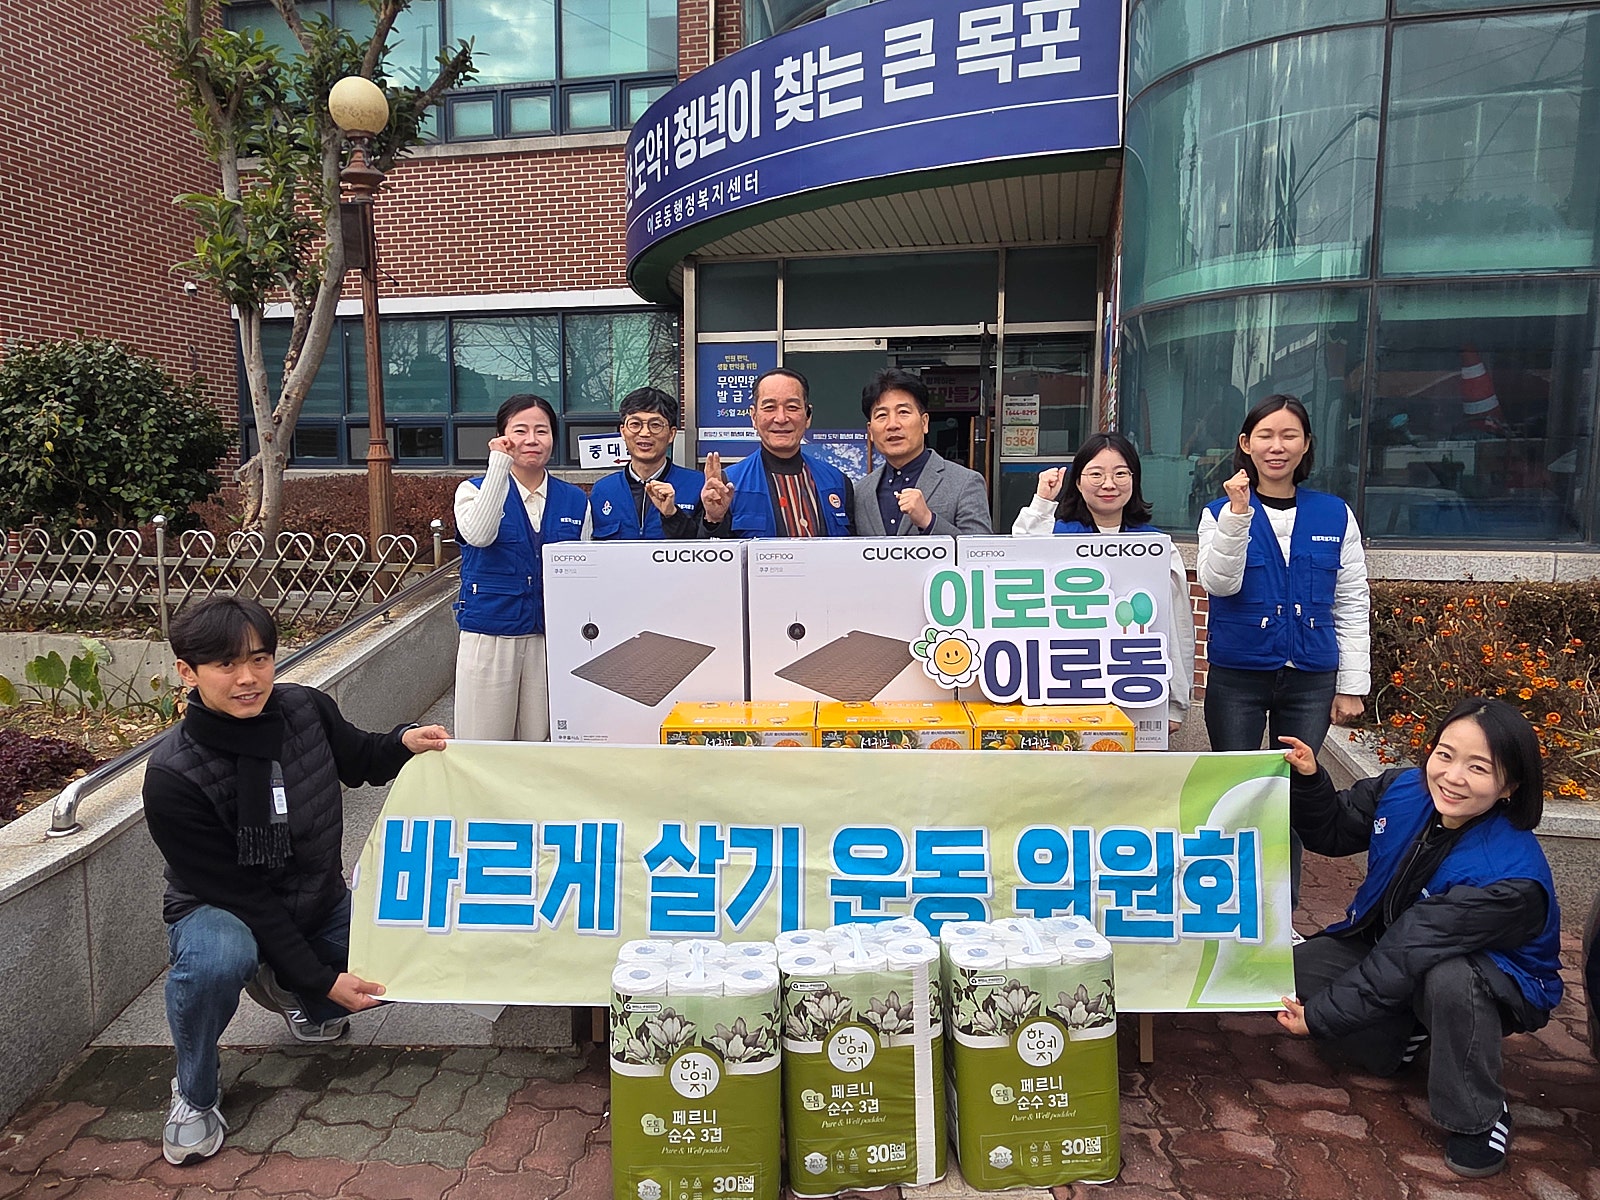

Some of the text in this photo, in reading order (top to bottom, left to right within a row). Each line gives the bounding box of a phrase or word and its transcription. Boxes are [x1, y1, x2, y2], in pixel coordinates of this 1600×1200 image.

[634, 116, 669, 200] 도약!
[673, 70, 761, 170] 청년이
[774, 46, 863, 131] 찾는
[882, 18, 935, 103] 큰
[956, 0, 1080, 83] 목표
[647, 169, 758, 235] 이로동행정복지센터
[1005, 436, 1035, 446] 5364
[652, 549, 734, 563] CUCKOO
[862, 546, 947, 561] CUCKOO
[1076, 543, 1163, 558] CUCKOO
[929, 567, 1110, 629] 이로운
[983, 638, 1167, 702] 이로동
[861, 736, 891, 749] 서귀포
[1021, 736, 1051, 749] 서귀포
[375, 817, 1260, 942] 바르게 살기 운동 위원회
[831, 1081, 873, 1099] 페르니
[1020, 1075, 1063, 1092] 페르니
[827, 1098, 879, 1116] 순수 3겹
[1016, 1092, 1069, 1111] 순수 3겹
[672, 1109, 717, 1125] 페르니
[821, 1120, 837, 1129] Pure
[1010, 1114, 1027, 1122] Pure
[668, 1127, 722, 1143] 순수 3겹
[867, 1142, 905, 1164] 30 Roll
[1061, 1136, 1101, 1156] 30 Roll
[713, 1175, 754, 1193] 30 Roll
